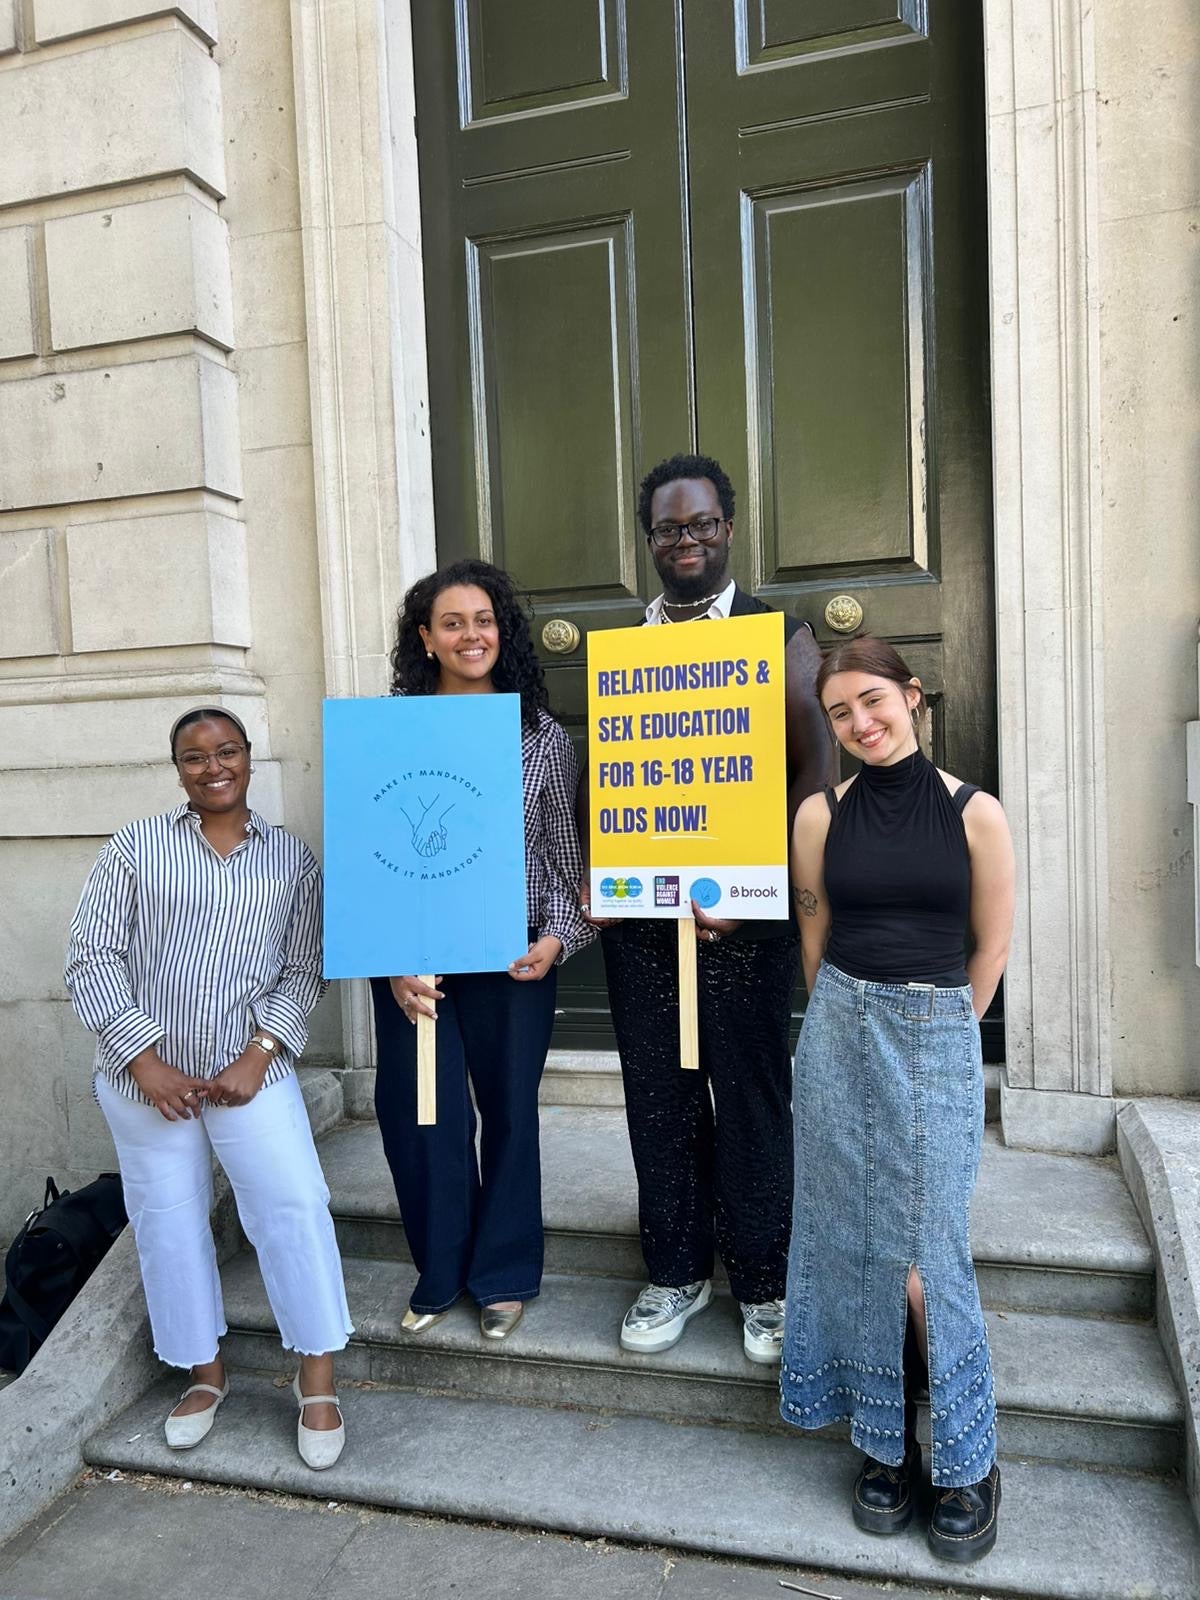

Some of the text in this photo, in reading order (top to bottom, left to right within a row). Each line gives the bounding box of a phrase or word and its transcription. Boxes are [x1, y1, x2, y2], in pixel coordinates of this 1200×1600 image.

[598, 658, 770, 697] RELATIONSHIPS &
[598, 707, 750, 743] SEX EDUCATION
[373, 769, 483, 802] MAKE IT MANDATORY
[599, 755, 753, 788] FOR 16-18 YEAR
[599, 805, 707, 834] OLDS NOW!
[373, 847, 483, 880] MAKE IT MANDATORY
[741, 886, 778, 898] brook
